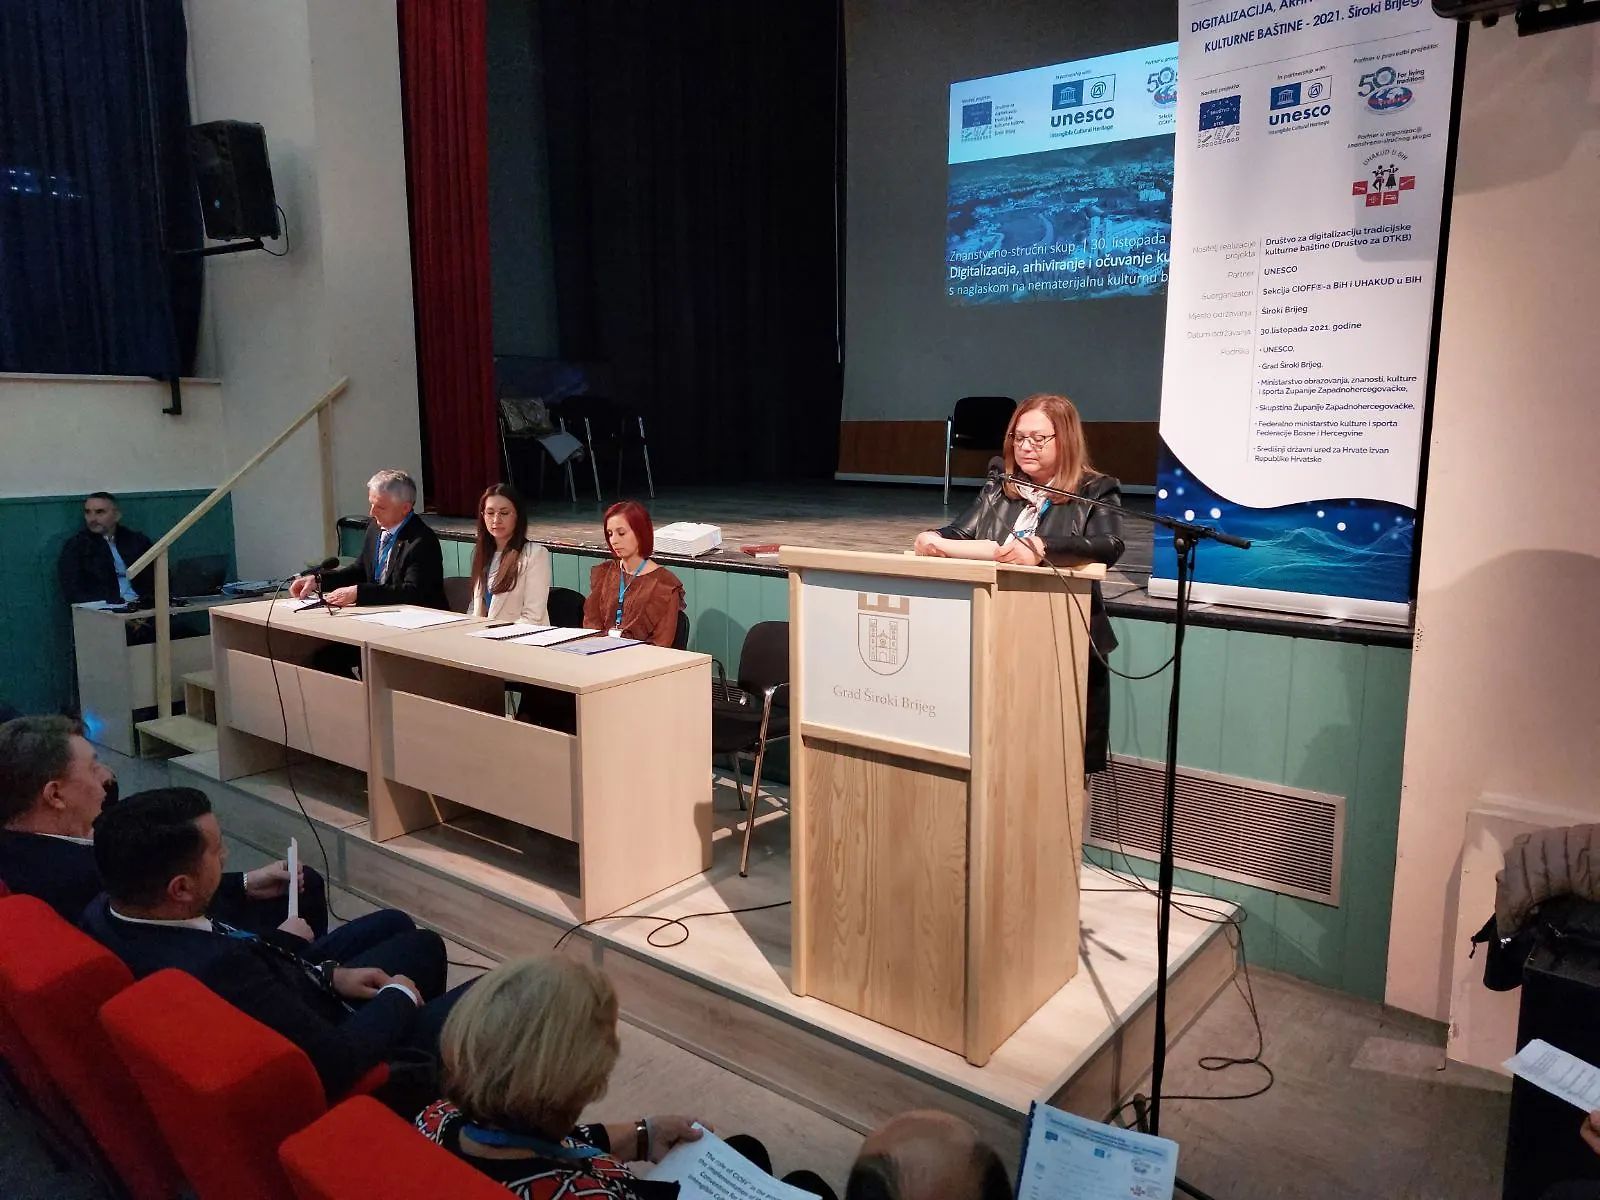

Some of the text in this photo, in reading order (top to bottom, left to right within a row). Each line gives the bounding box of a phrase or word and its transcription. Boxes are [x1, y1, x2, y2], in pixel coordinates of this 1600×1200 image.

[1191, 2, 1277, 33] DIGITALIZACIJA,
[1204, 30, 1255, 52] KULTURNE
[1257, 18, 1303, 39] BAŠTINE
[1313, 10, 1345, 27] 2021.
[1348, 2, 1381, 19] Široki
[1050, 106, 1115, 128] unesco
[1268, 104, 1331, 126] unesco
[1266, 236, 1296, 246] Društvo
[1308, 228, 1362, 242] digitalizaciju
[1364, 224, 1412, 235] tradicijske
[1266, 246, 1298, 256] kulturne
[1300, 242, 1330, 252] baštine
[1331, 238, 1368, 248] (Društvo
[1382, 234, 1412, 244] DTKB)
[950, 244, 1048, 262] Znanstveno-stručni
[1112, 233, 1166, 250] listopada
[950, 262, 1020, 280] Digitalizacija,
[1023, 256, 1086, 274] arhiviranje
[1096, 250, 1153, 268] očuvanje
[1264, 266, 1298, 276] UNESCO
[949, 287, 954, 296] s
[958, 281, 1009, 297] naglaskom
[1012, 282, 1025, 292] na
[1028, 274, 1104, 292] nematerijalnu
[1107, 271, 1158, 286] kulturnu
[1262, 286, 1290, 297] Sekcija
[1333, 281, 1348, 290] BiH
[1354, 277, 1394, 288] UHAKUD
[1405, 276, 1422, 284] BiH
[1261, 305, 1308, 315] Široki Brijeg
[1332, 322, 1362, 332] godine
[1280, 360, 1300, 369] Široki
[1260, 378, 1303, 386] Ministarstvo
[1262, 388, 1284, 396] sporta
[1285, 387, 1316, 396] Županije
[1294, 402, 1324, 412] Županije
[1372, 420, 1398, 428] sporta
[832, 684, 936, 718] Grad Široki Brijeg
